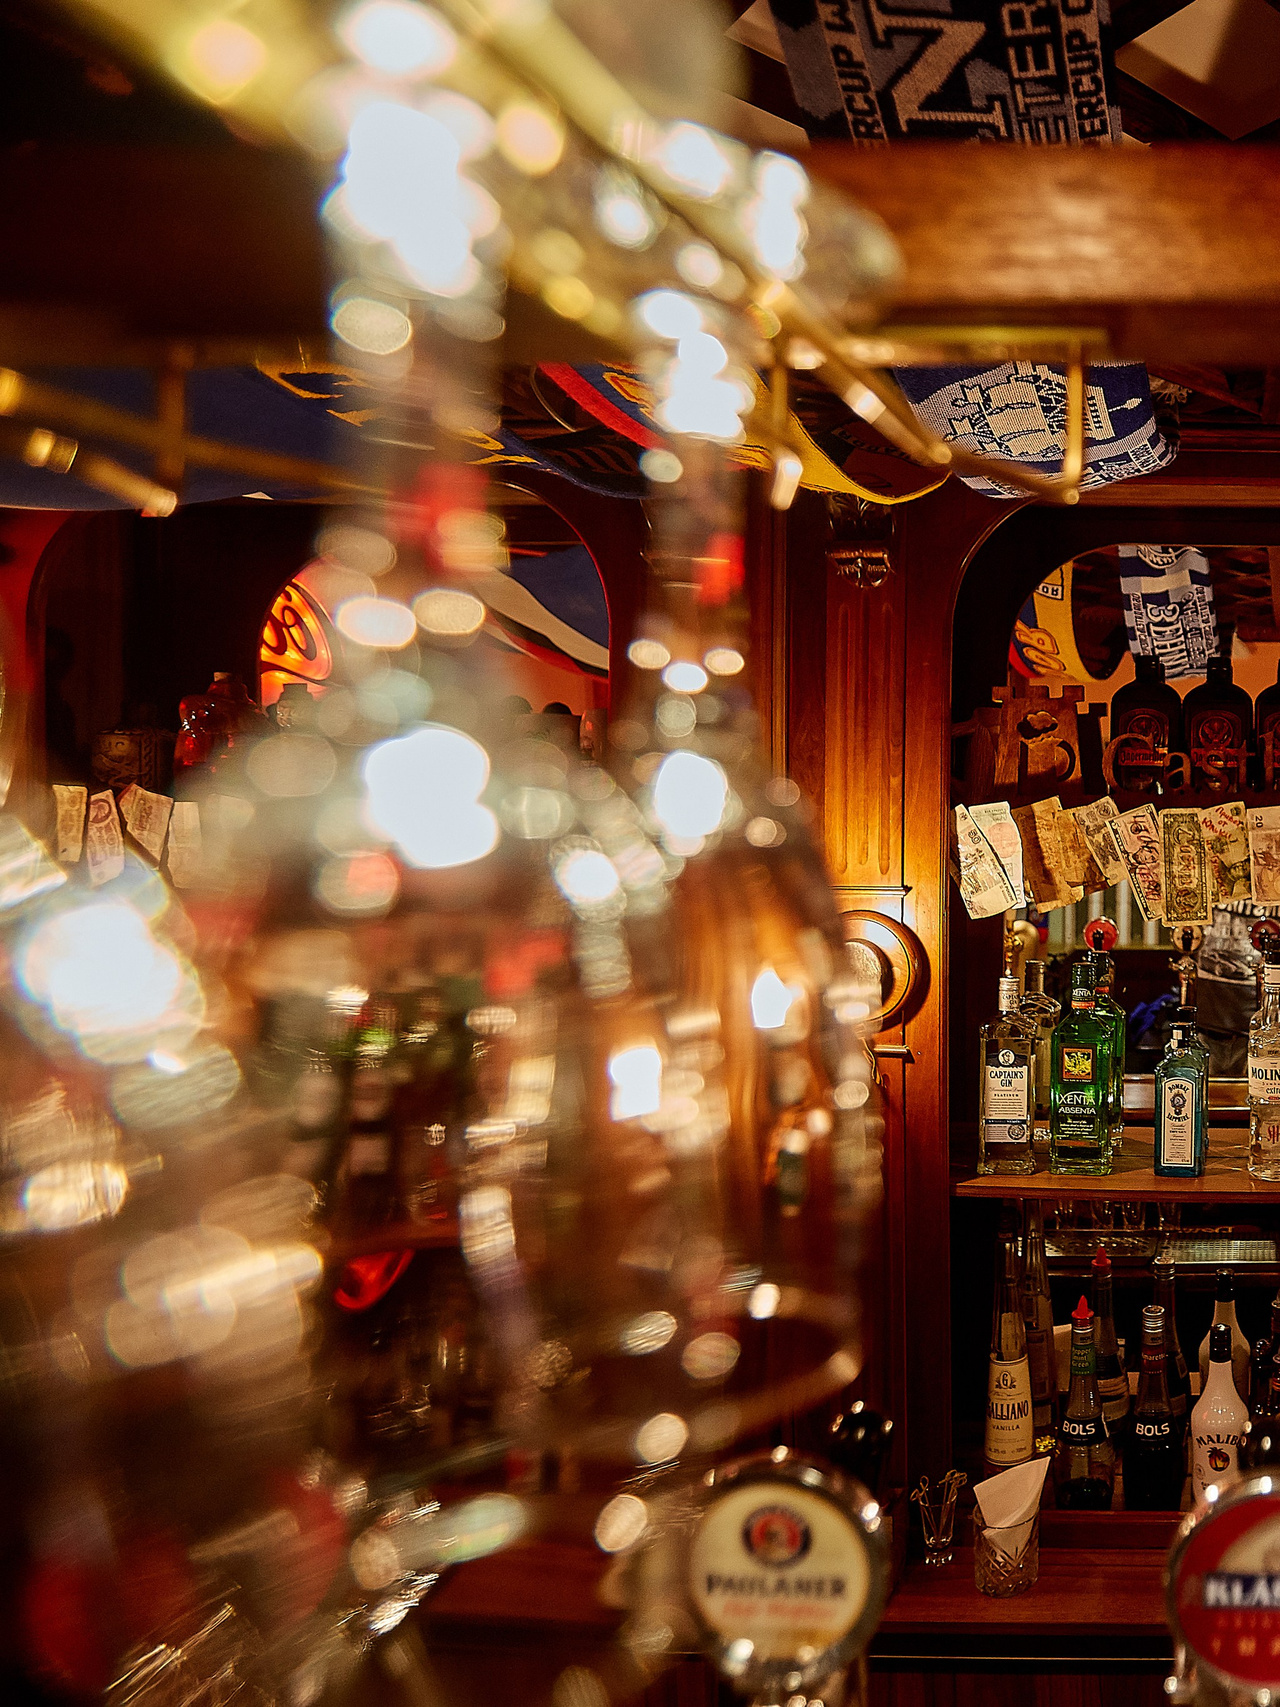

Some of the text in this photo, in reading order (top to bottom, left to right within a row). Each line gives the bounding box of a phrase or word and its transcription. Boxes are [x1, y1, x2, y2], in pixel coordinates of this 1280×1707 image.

[989, 1070, 1024, 1080] CAPTAIN'S
[1000, 1078, 1013, 1088] GIN
[1168, 1083, 1191, 1094] BOMBAY
[1058, 1092, 1096, 1106] XENTA
[1058, 1106, 1096, 1115] ABSENTA
[1062, 1421, 1096, 1435] BOLS
[1135, 1422, 1170, 1437] BOLS
